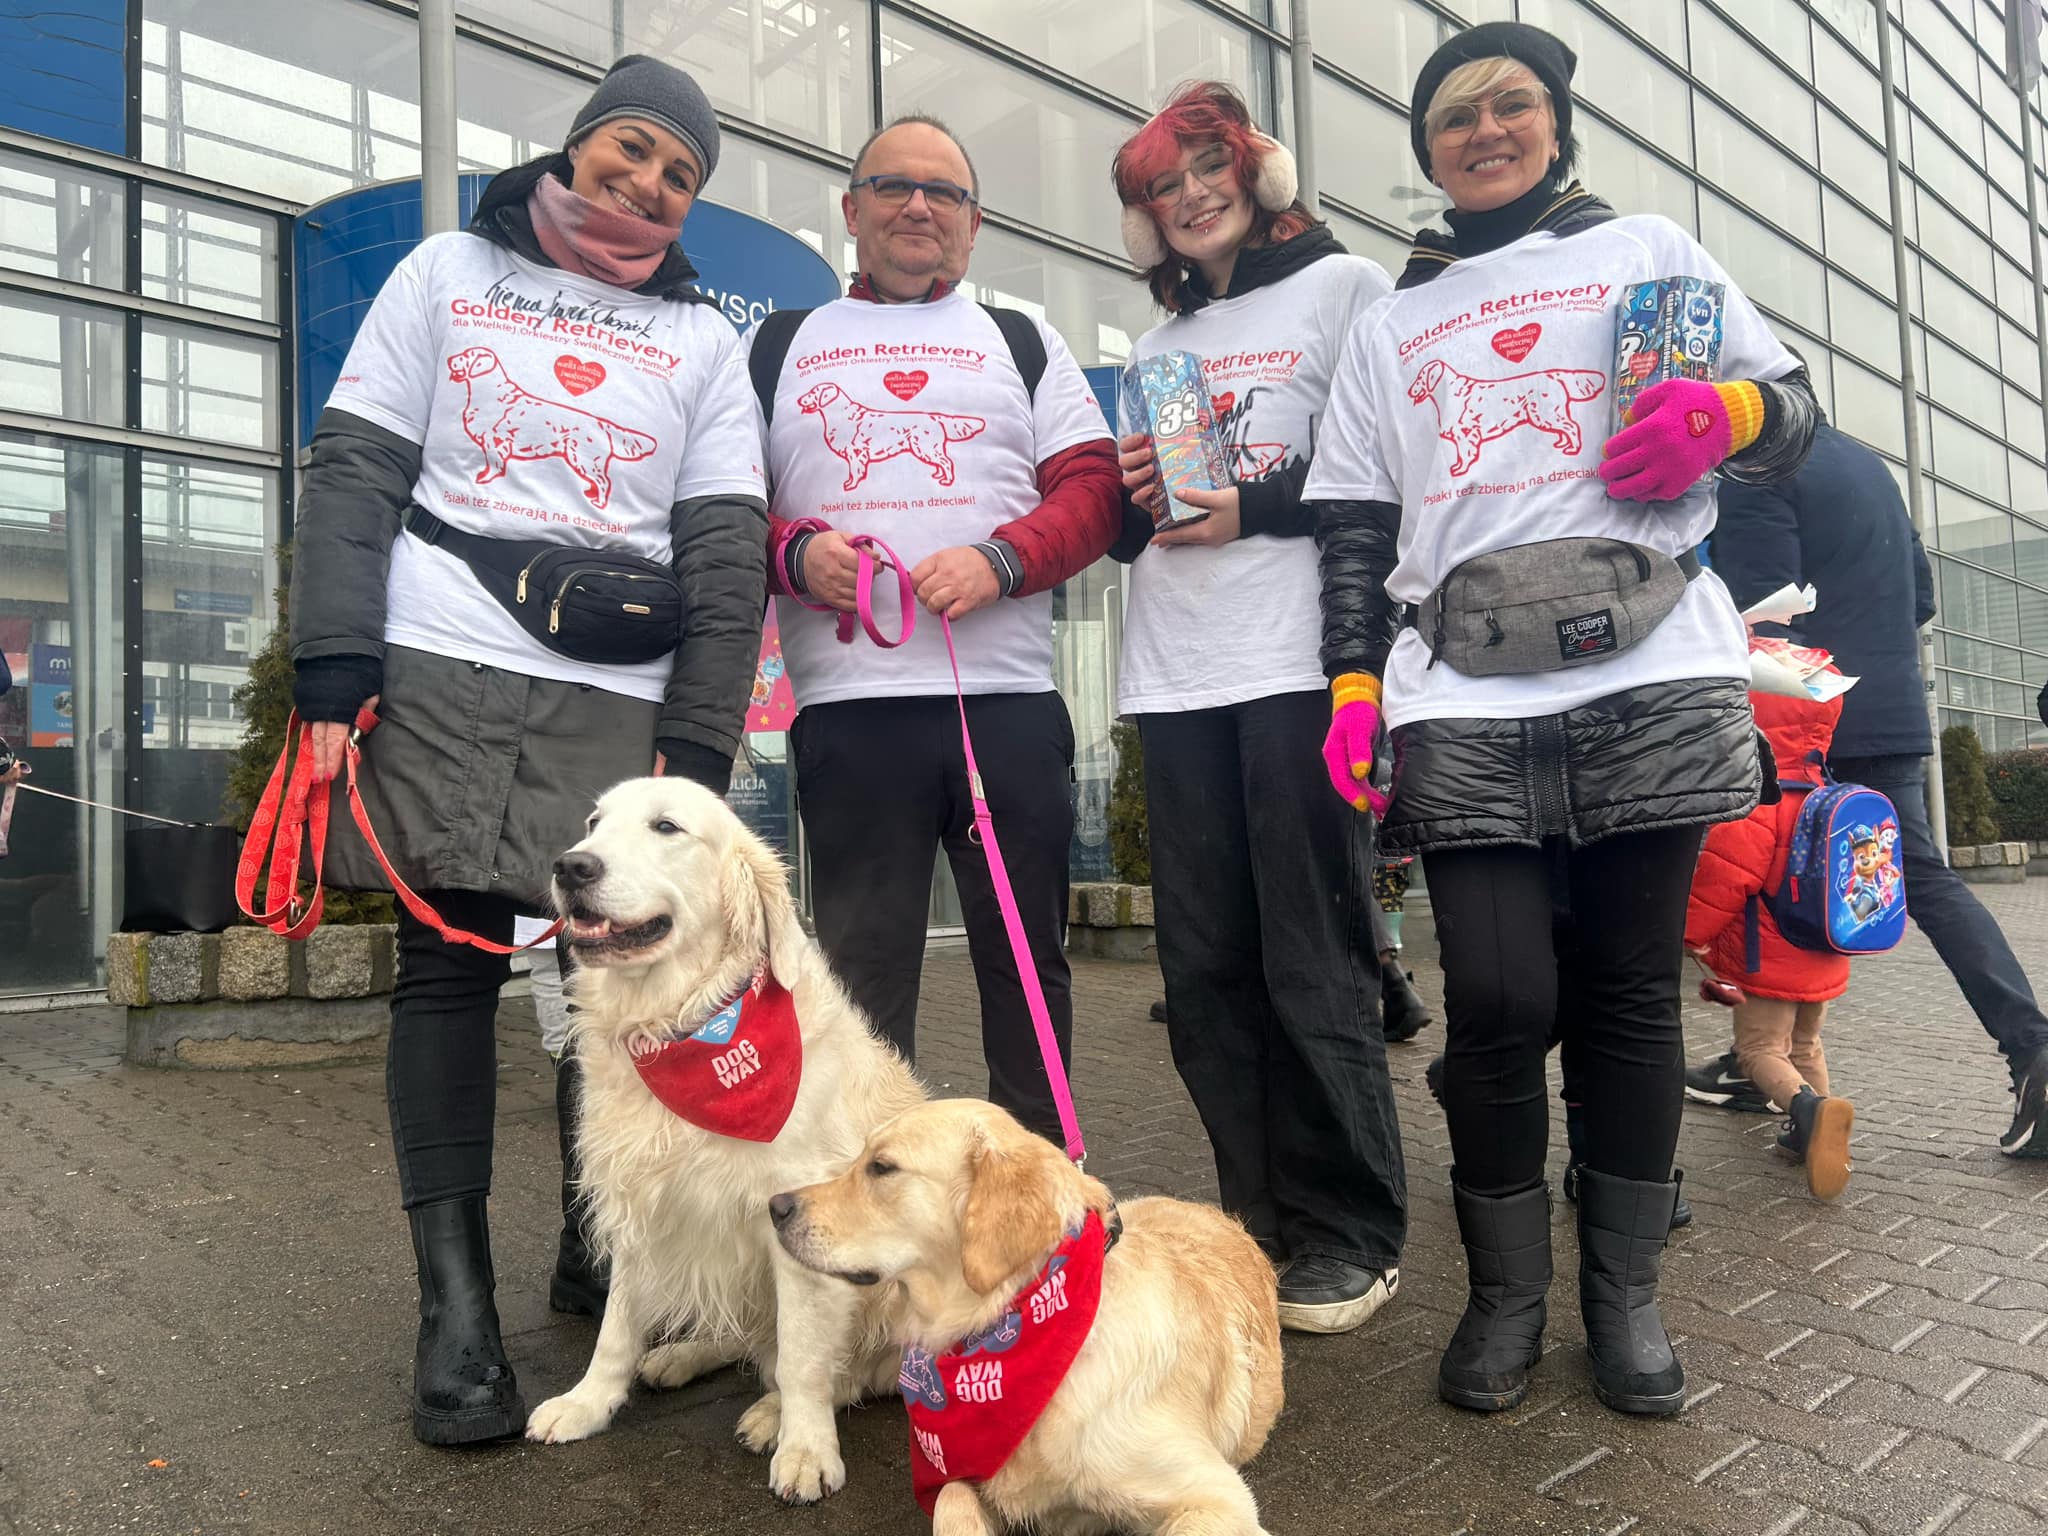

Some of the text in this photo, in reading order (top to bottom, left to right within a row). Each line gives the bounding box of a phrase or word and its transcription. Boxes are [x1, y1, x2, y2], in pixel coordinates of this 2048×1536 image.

[1398, 283, 1611, 356] Golden Retrievery
[1691, 304, 1709, 318] tvn
[451, 298, 683, 368] Golden Retrievery
[1402, 298, 1607, 366] dla Wielkiej Orkiestry Świątecznej Pomocy
[452, 318, 674, 378] dla Wielkiej Orkiestry Świątecznej Pomocy
[796, 341, 986, 369] Golden Retrievery
[1202, 350, 1303, 374] Retrievery
[799, 355, 984, 378] dla Wielkiej Orkiestry Świątecznej Pomocy
[1261, 366, 1296, 377] Pomocy
[1156, 390, 1200, 438] 33
[821, 503, 844, 513] Psiaki
[847, 502, 862, 511] też
[865, 501, 908, 511] zbierają
[927, 495, 976, 507] dzieciaki!
[1423, 489, 1451, 506] Psiaki
[1456, 486, 1474, 497] też
[1478, 481, 1527, 495] zbierają
[1528, 475, 1544, 487] na
[443, 490, 469, 506] Psiaki
[472, 495, 489, 508] też
[493, 501, 548, 522] zbierają
[552, 512, 568, 523] na
[1561, 623, 1576, 635] LEE
[1577, 616, 1608, 631] COOPER
[712, 1039, 757, 1077] DOG
[718, 1051, 762, 1089] WAY
[1033, 1287, 1069, 1324] DOG
[955, 1360, 1003, 1384] WAY
[956, 1378, 1003, 1403] DOG
